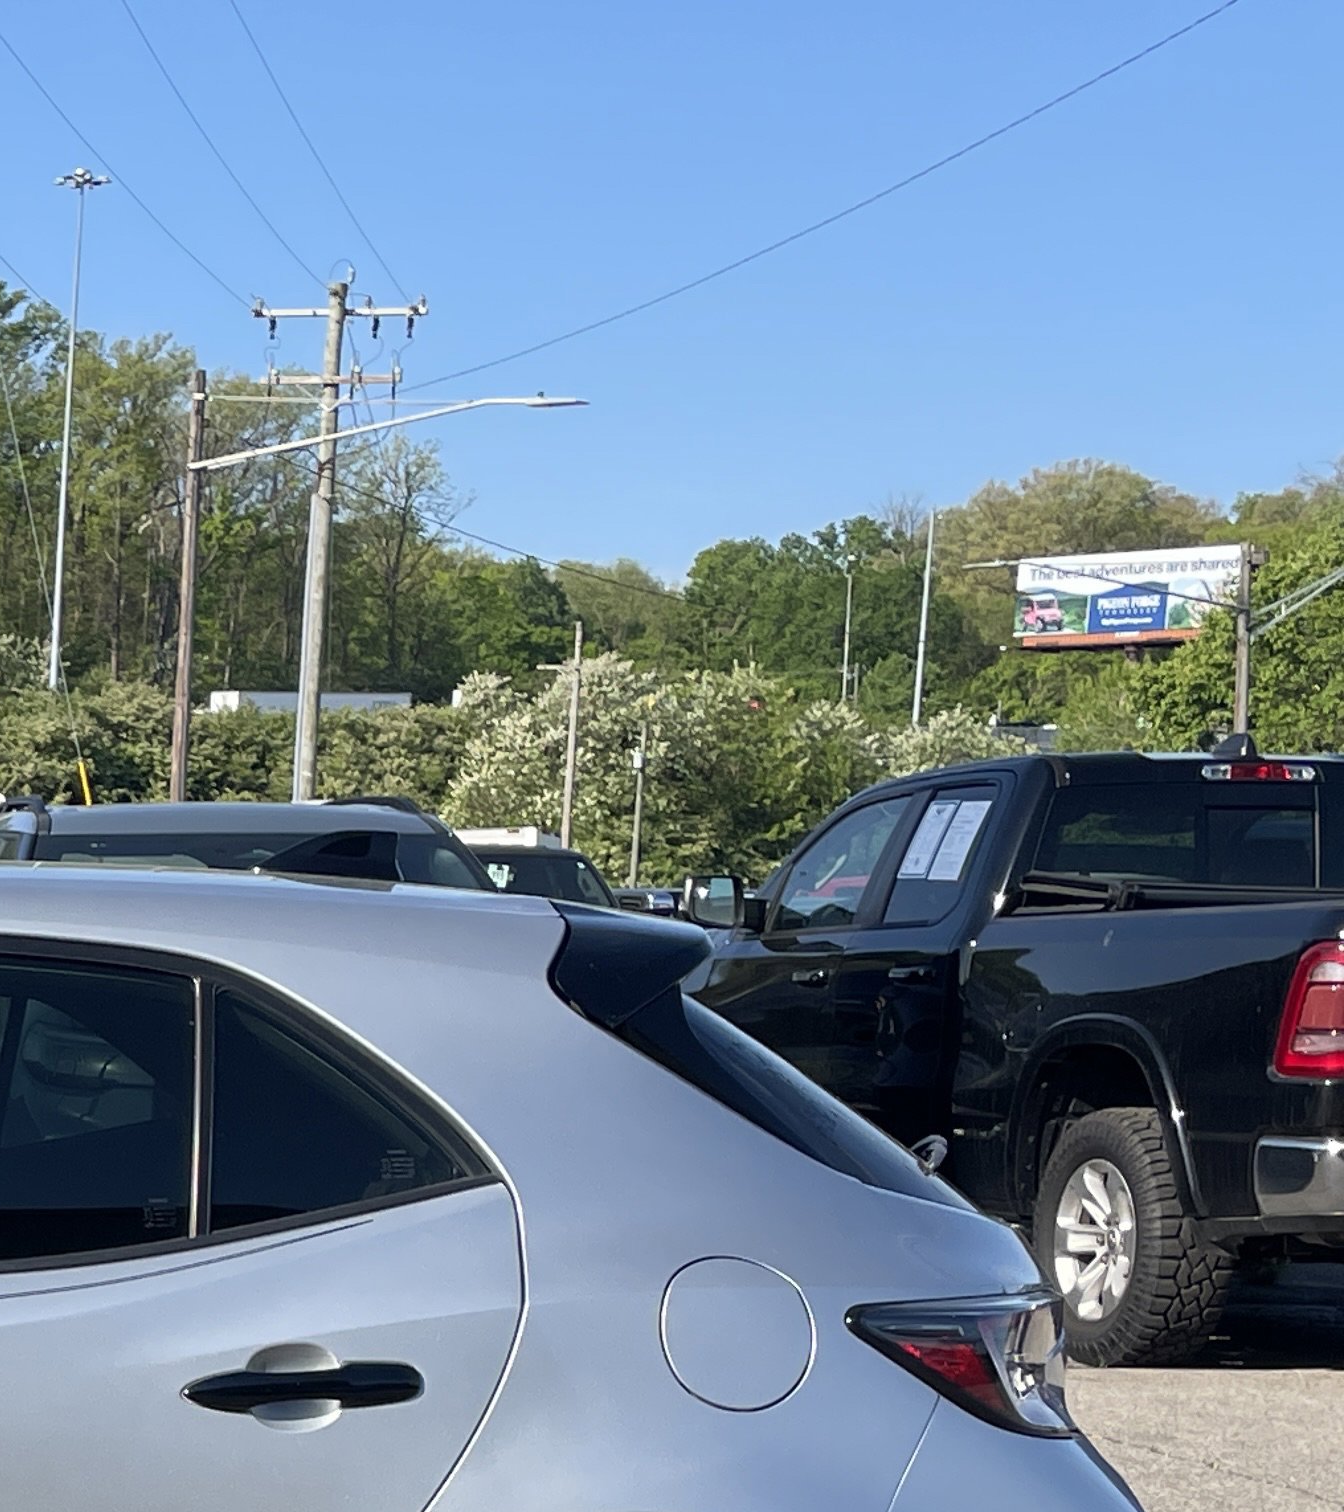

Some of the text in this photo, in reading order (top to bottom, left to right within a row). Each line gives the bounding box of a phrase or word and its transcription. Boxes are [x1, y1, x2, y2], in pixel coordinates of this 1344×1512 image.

[1031, 568, 1054, 581] The
[1090, 562, 1163, 577] adventures
[1166, 560, 1188, 573] are
[1191, 557, 1240, 572] shared
